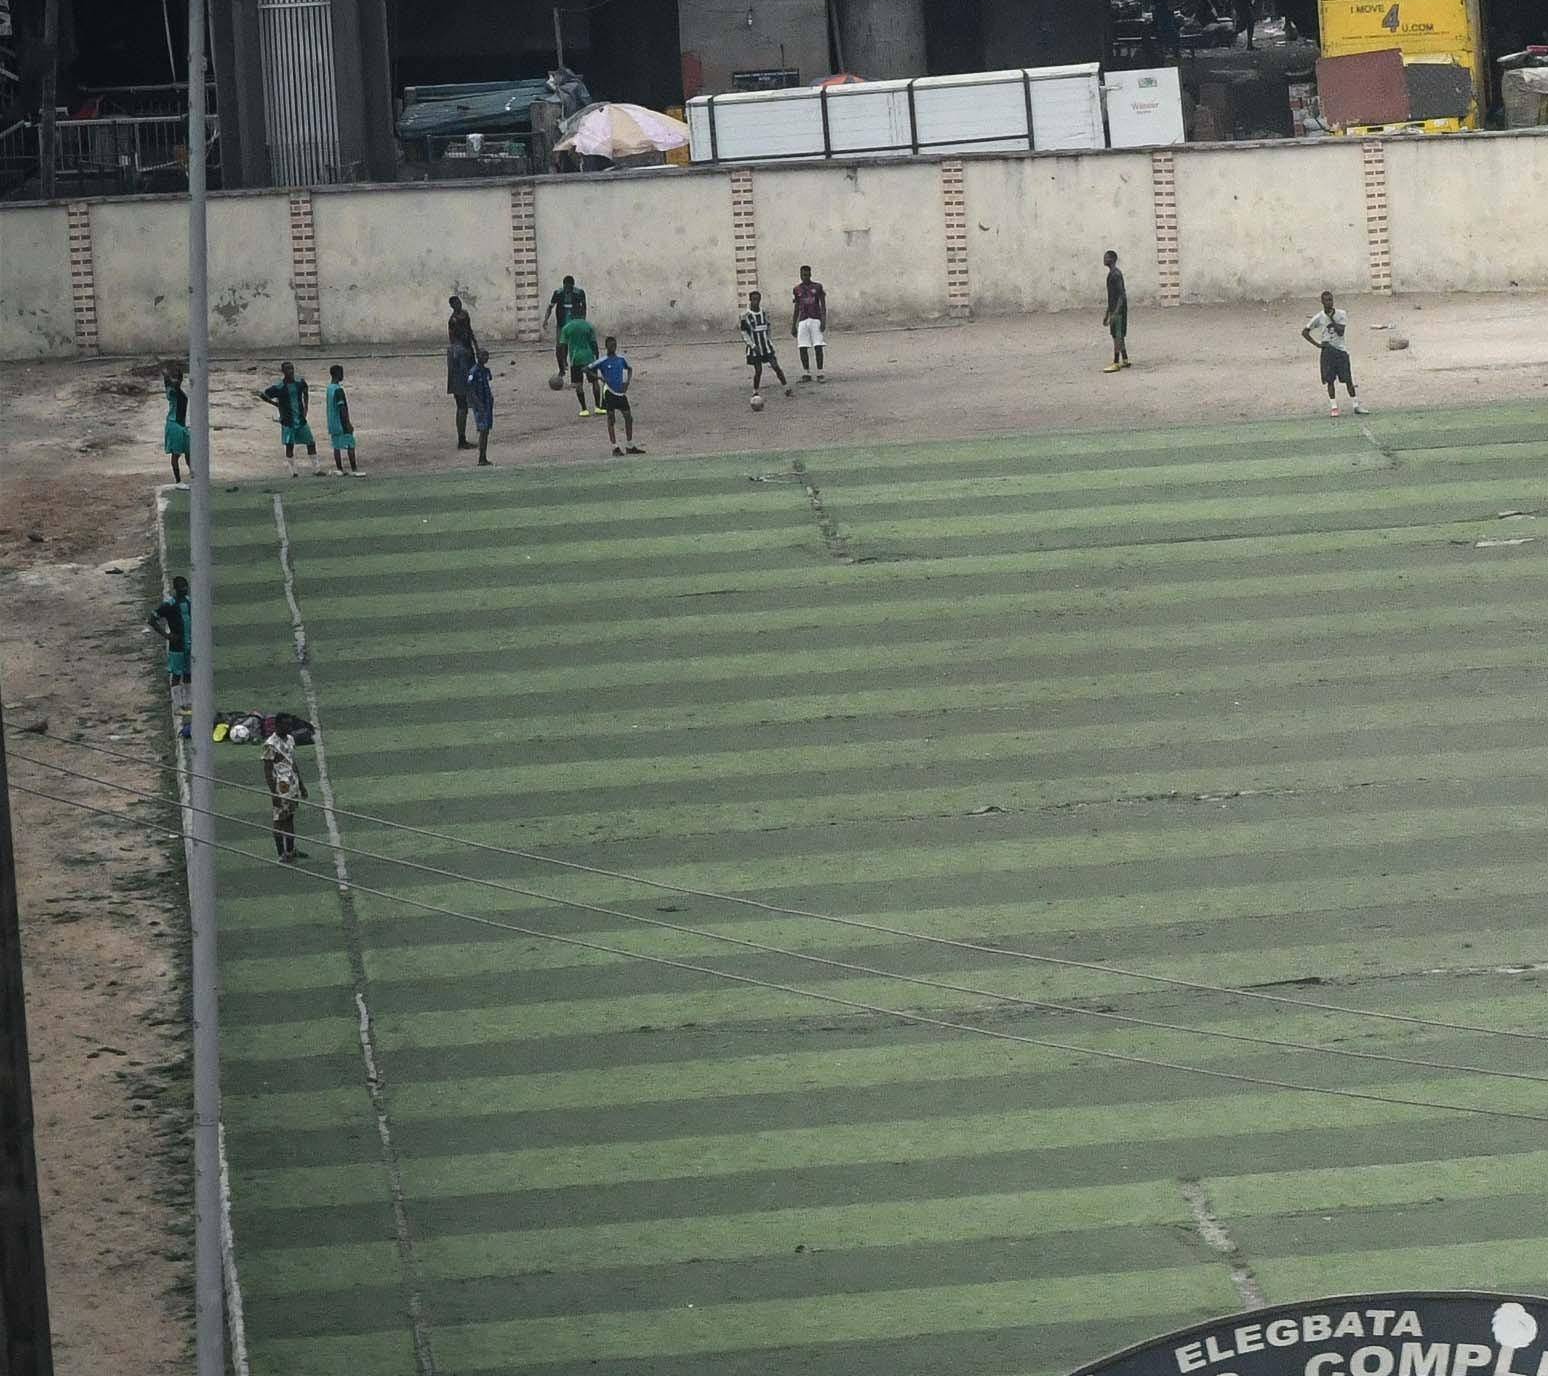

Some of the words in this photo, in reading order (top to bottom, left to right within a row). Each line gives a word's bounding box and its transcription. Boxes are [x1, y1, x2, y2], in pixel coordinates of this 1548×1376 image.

[1356, 4, 1384, 13] MOVE
[1381, 3, 1399, 33] 4
[1401, 23, 1434, 33] U.COM
[1174, 1309, 1424, 1375] ELEGBATA
